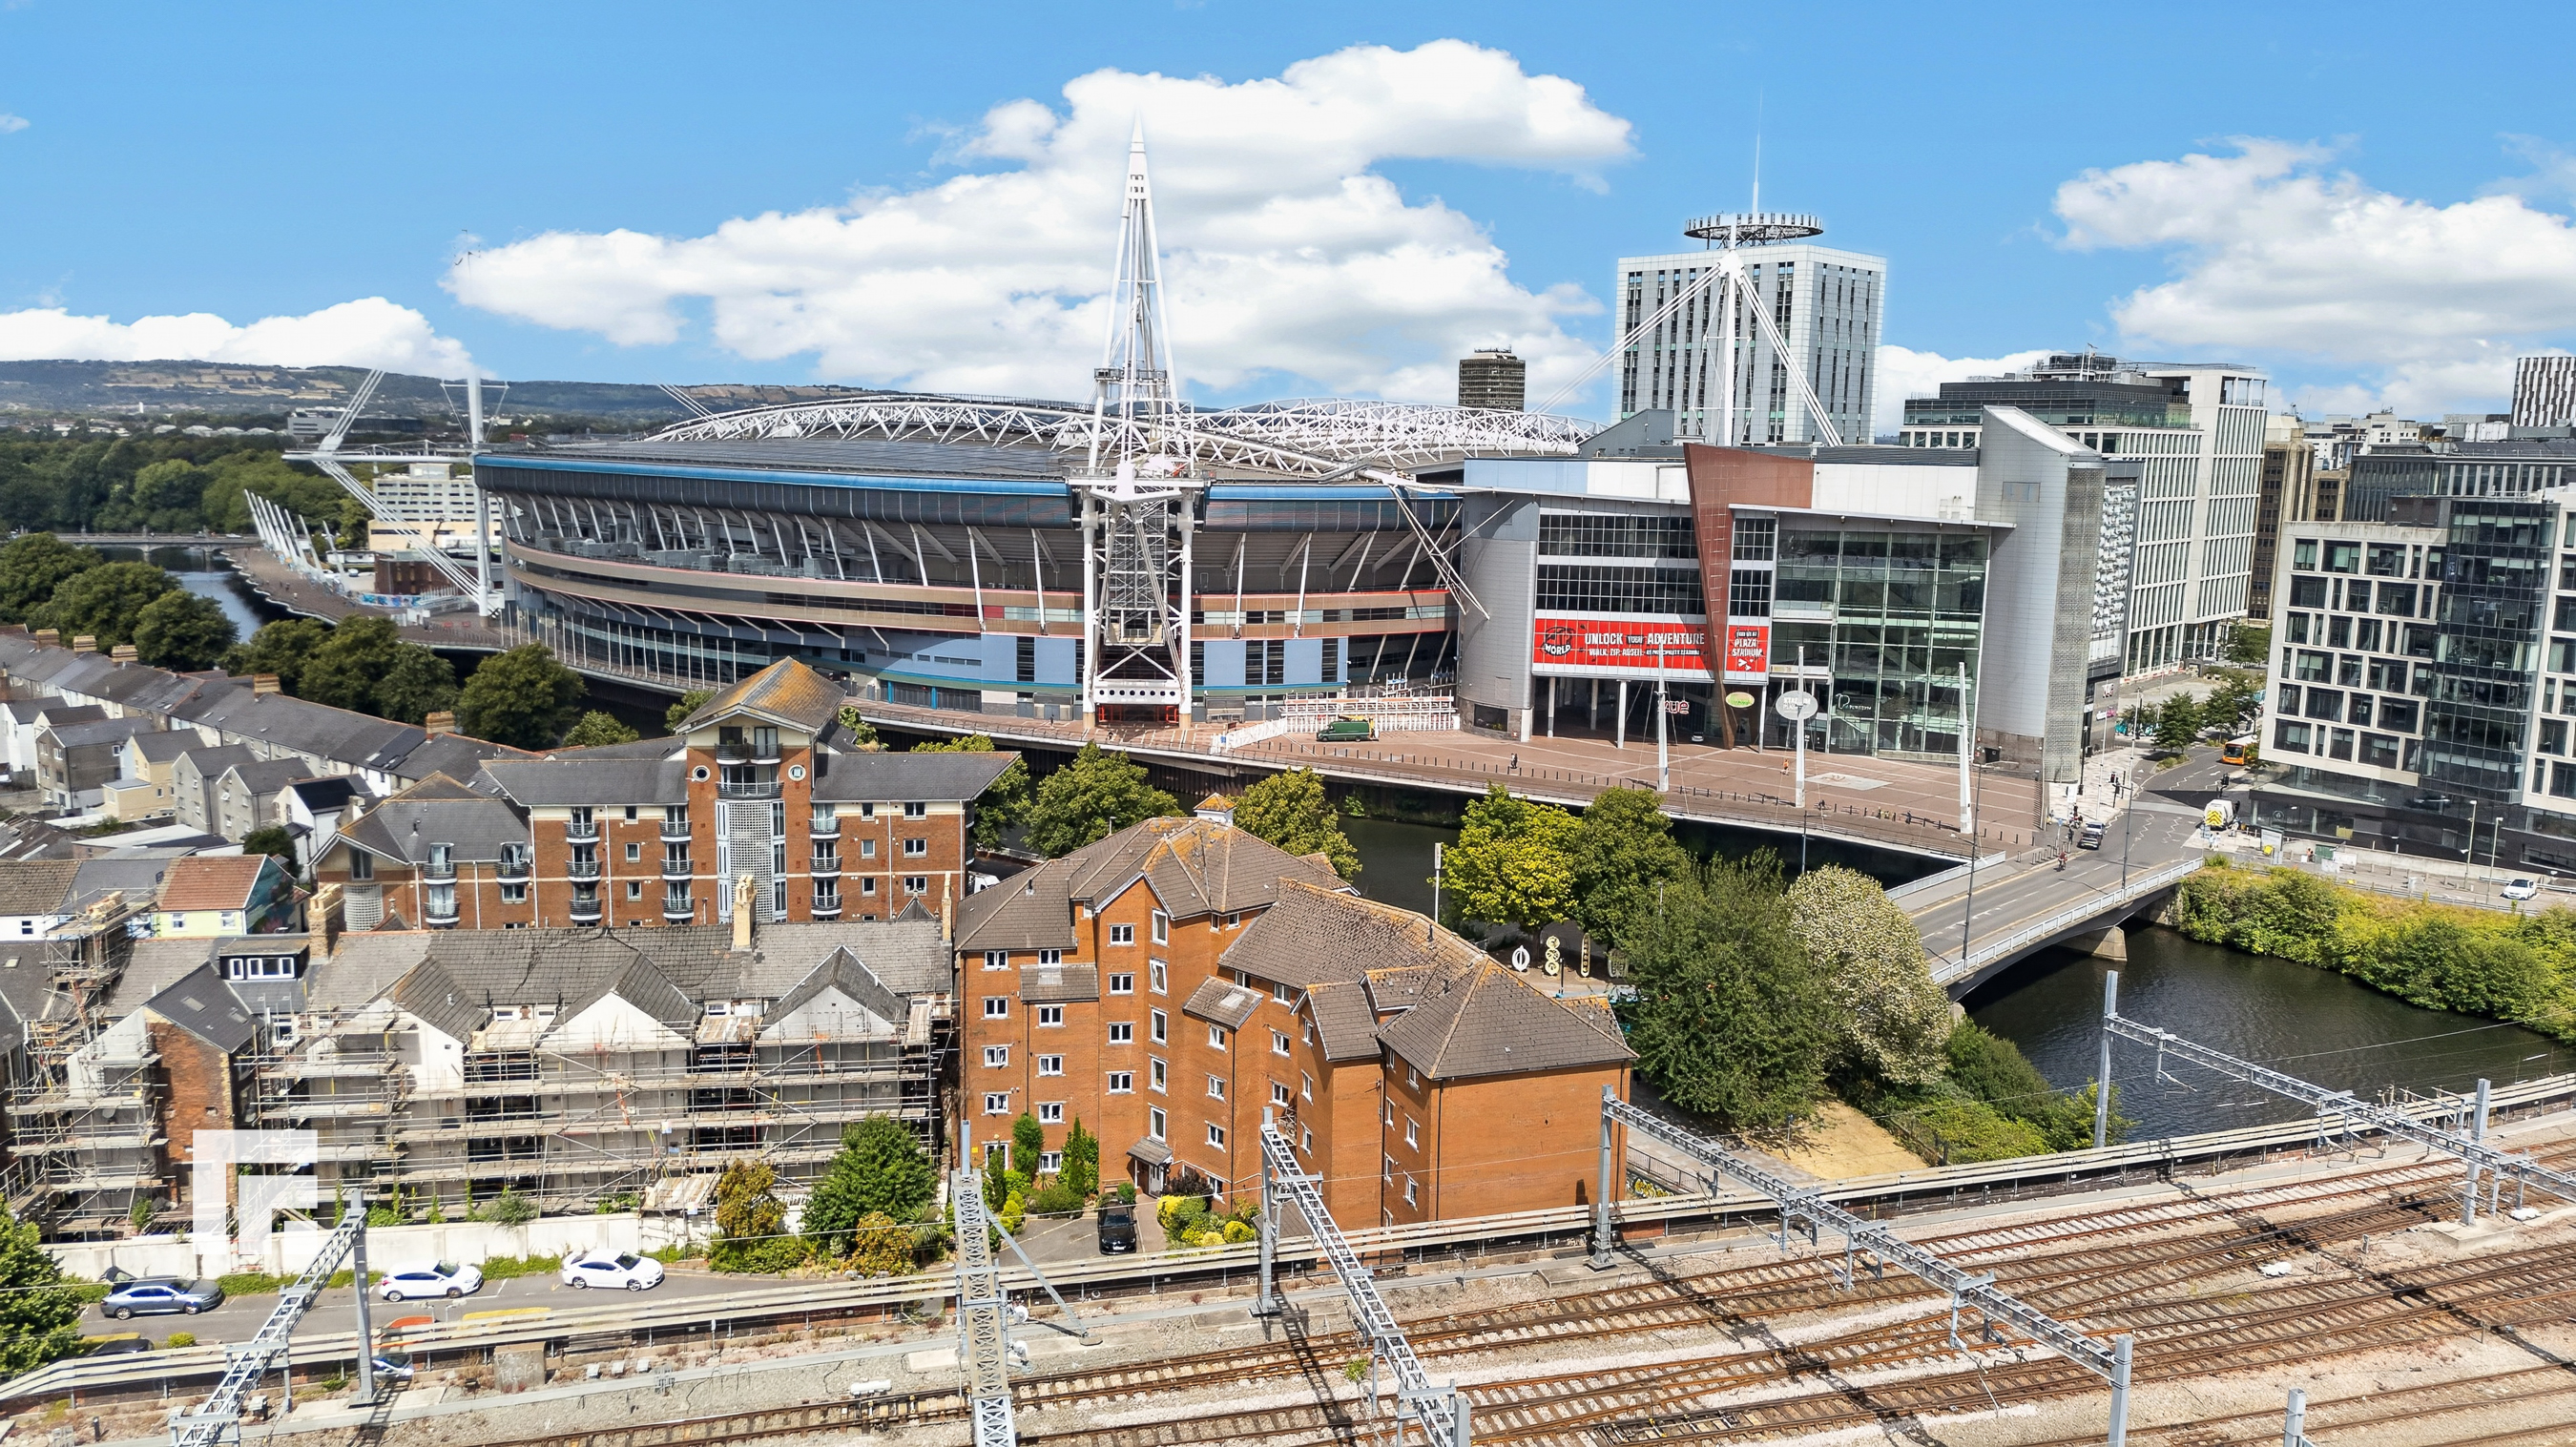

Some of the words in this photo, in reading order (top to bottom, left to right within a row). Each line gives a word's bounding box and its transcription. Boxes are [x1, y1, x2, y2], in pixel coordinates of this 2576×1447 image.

[1585, 632, 1624, 645] UNLOCK
[1647, 632, 1705, 645] ADVENTURE
[1734, 638, 1756, 647] PLAZA
[1544, 643, 1571, 655] WORLD
[1732, 648, 1762, 656] STADIUM
